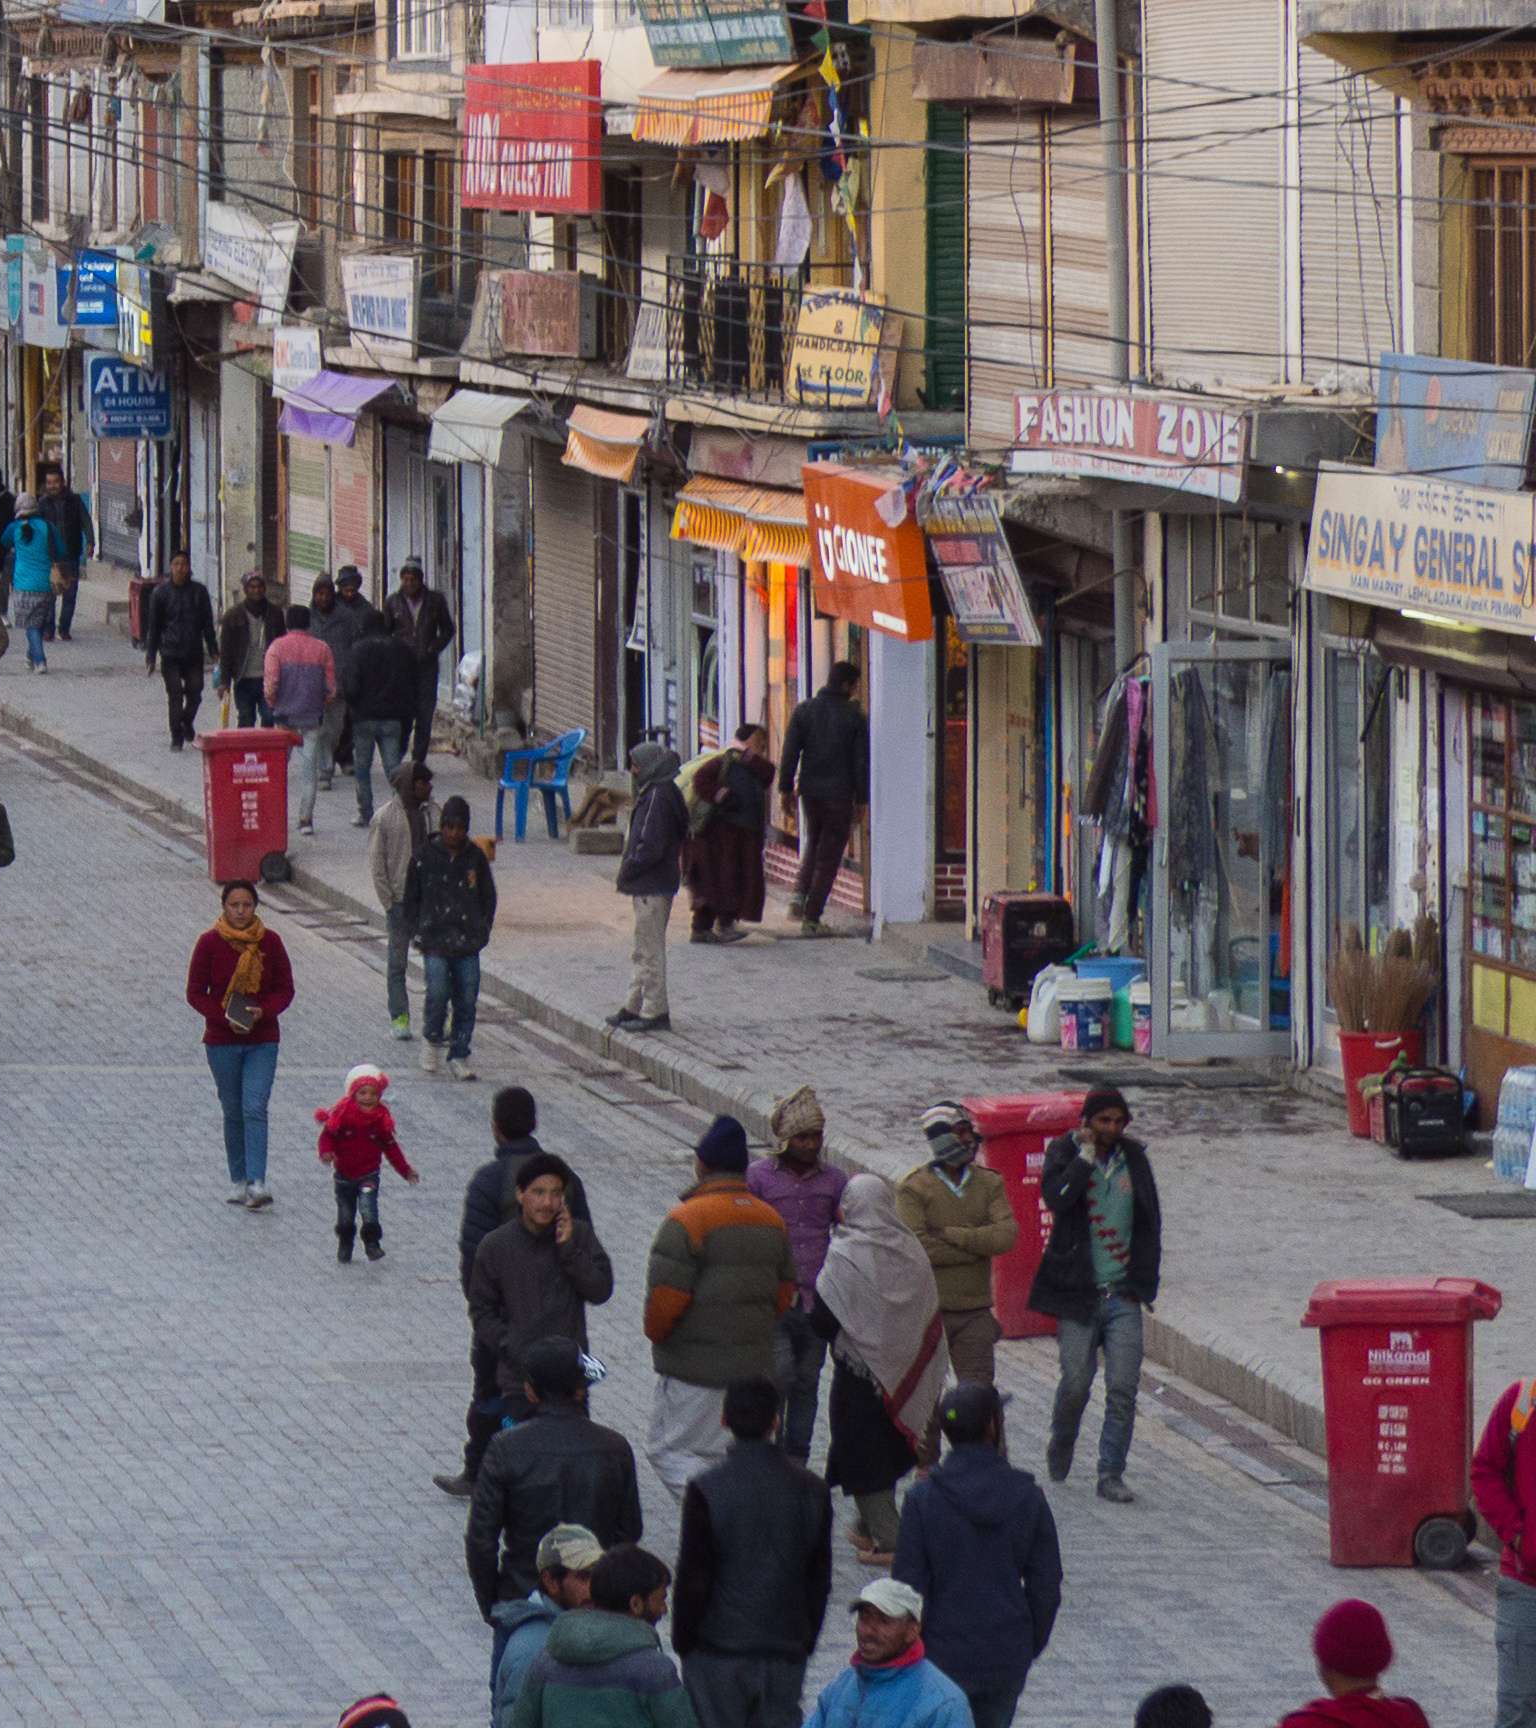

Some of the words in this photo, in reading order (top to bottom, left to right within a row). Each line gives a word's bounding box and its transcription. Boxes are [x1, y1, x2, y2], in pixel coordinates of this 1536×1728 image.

[466, 112, 500, 198] KIDS
[500, 140, 573, 199] COLLECTION
[94, 366, 166, 394] ATM
[1018, 394, 1136, 450] FASHION
[1156, 402, 1243, 470] ZONE
[833, 524, 889, 584] GIONEE
[1318, 508, 1407, 574] SINGAY
[1413, 525, 1504, 592] GENERAL
[1362, 1377, 1382, 1386] GO
[1385, 1376, 1430, 1386] GREEN
[1368, 1348, 1431, 1365] Nilkamal
